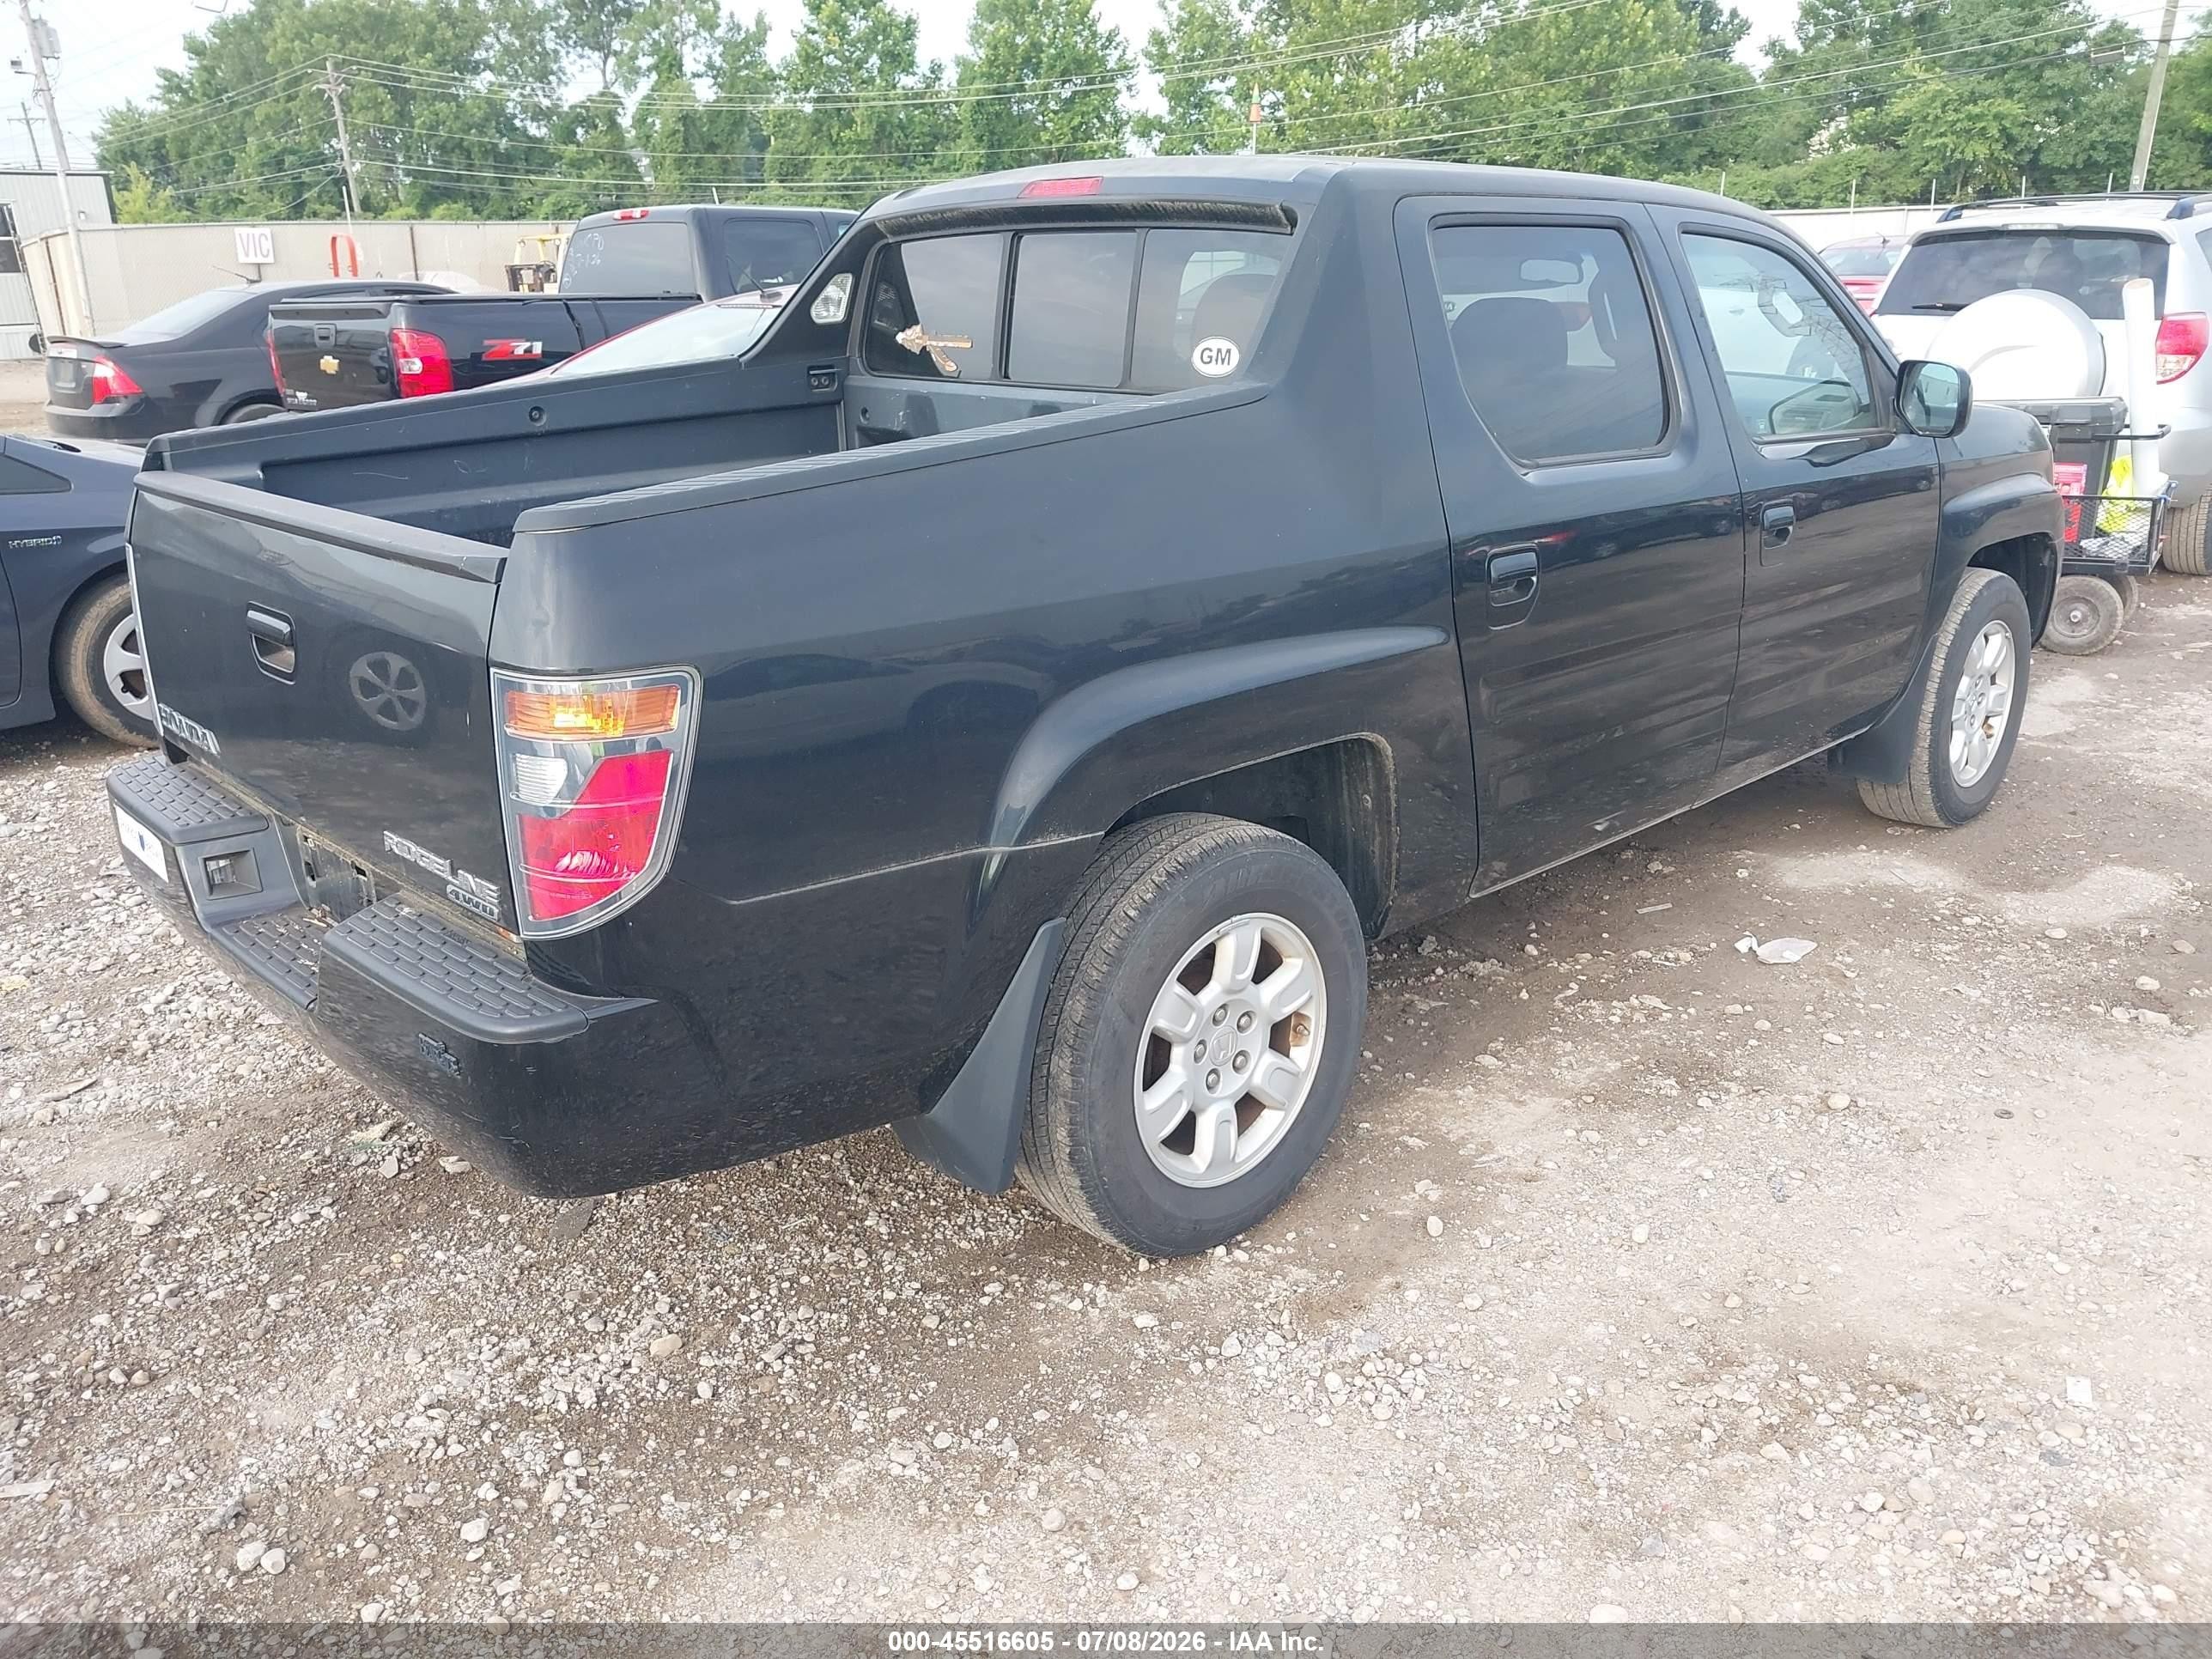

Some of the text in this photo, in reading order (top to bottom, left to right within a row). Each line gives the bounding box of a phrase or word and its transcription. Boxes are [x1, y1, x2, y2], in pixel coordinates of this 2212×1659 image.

[239, 233, 270, 258] VIC
[482, 338, 543, 360] Z71
[1200, 347, 1231, 366] GM
[8, 537, 53, 549] HYBRID
[158, 702, 221, 757] HONDA
[384, 830, 501, 905] RIDGELINE
[446, 884, 501, 922] 4WD
